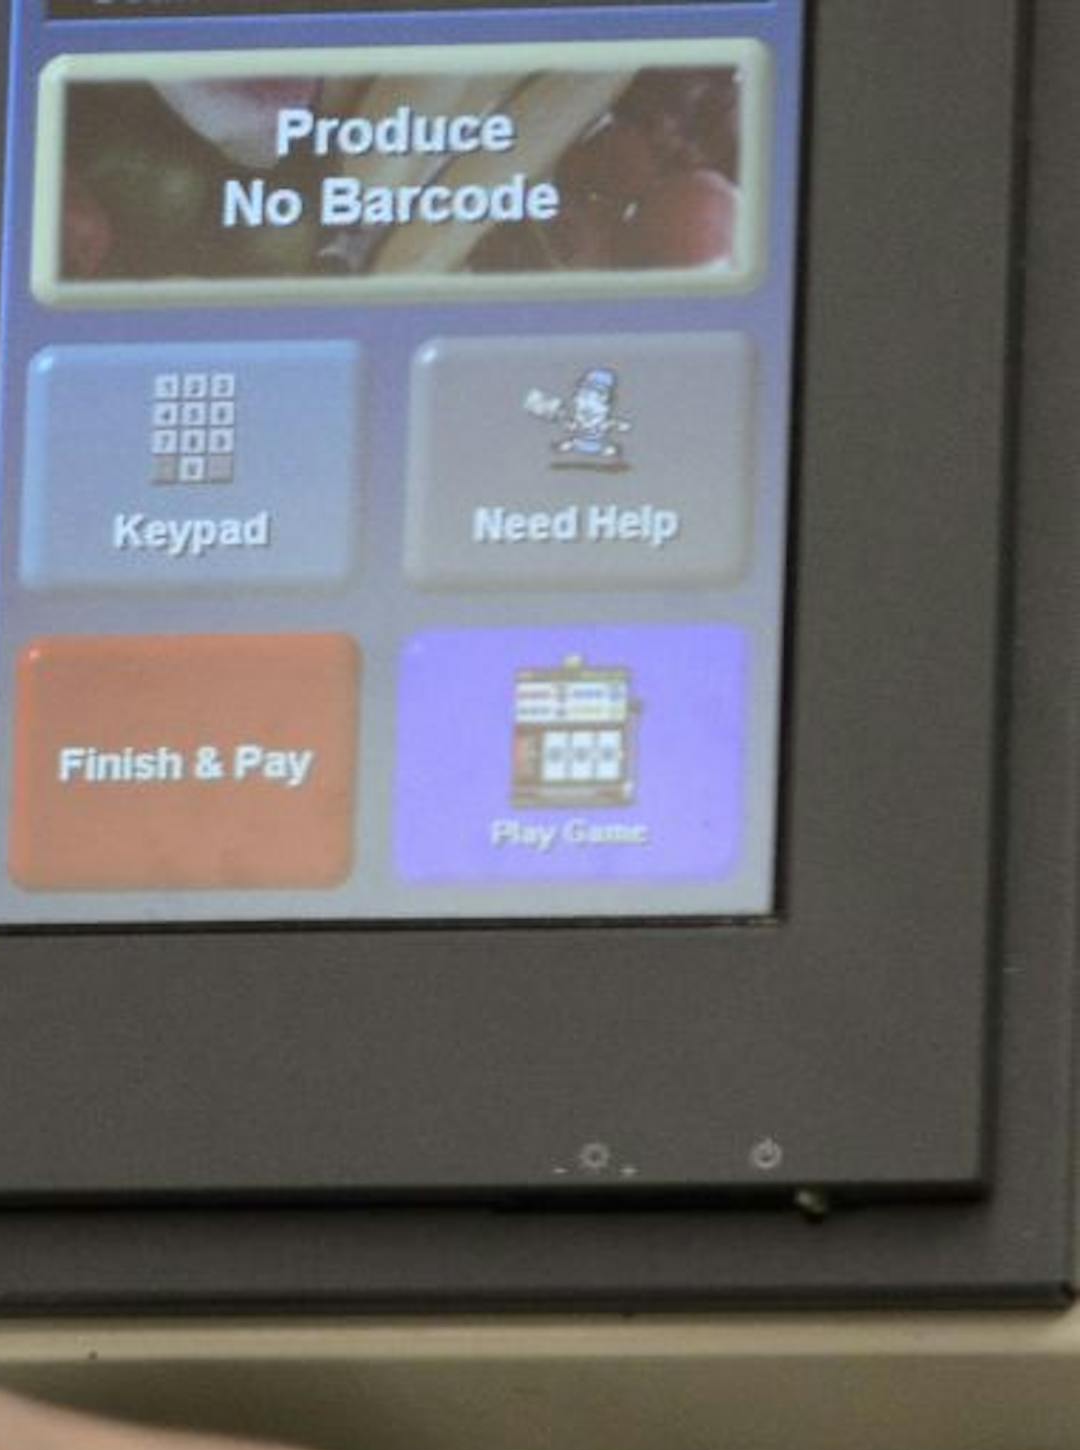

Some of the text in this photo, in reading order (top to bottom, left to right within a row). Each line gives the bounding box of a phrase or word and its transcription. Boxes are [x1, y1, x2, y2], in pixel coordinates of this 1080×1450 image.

[275, 107, 517, 157] Produce
[221, 174, 561, 230] No Barcode
[113, 511, 270, 558] Keypad
[472, 505, 679, 547] Need Help
[58, 744, 315, 788] Finish & Pay
[491, 817, 649, 850] Play Game
